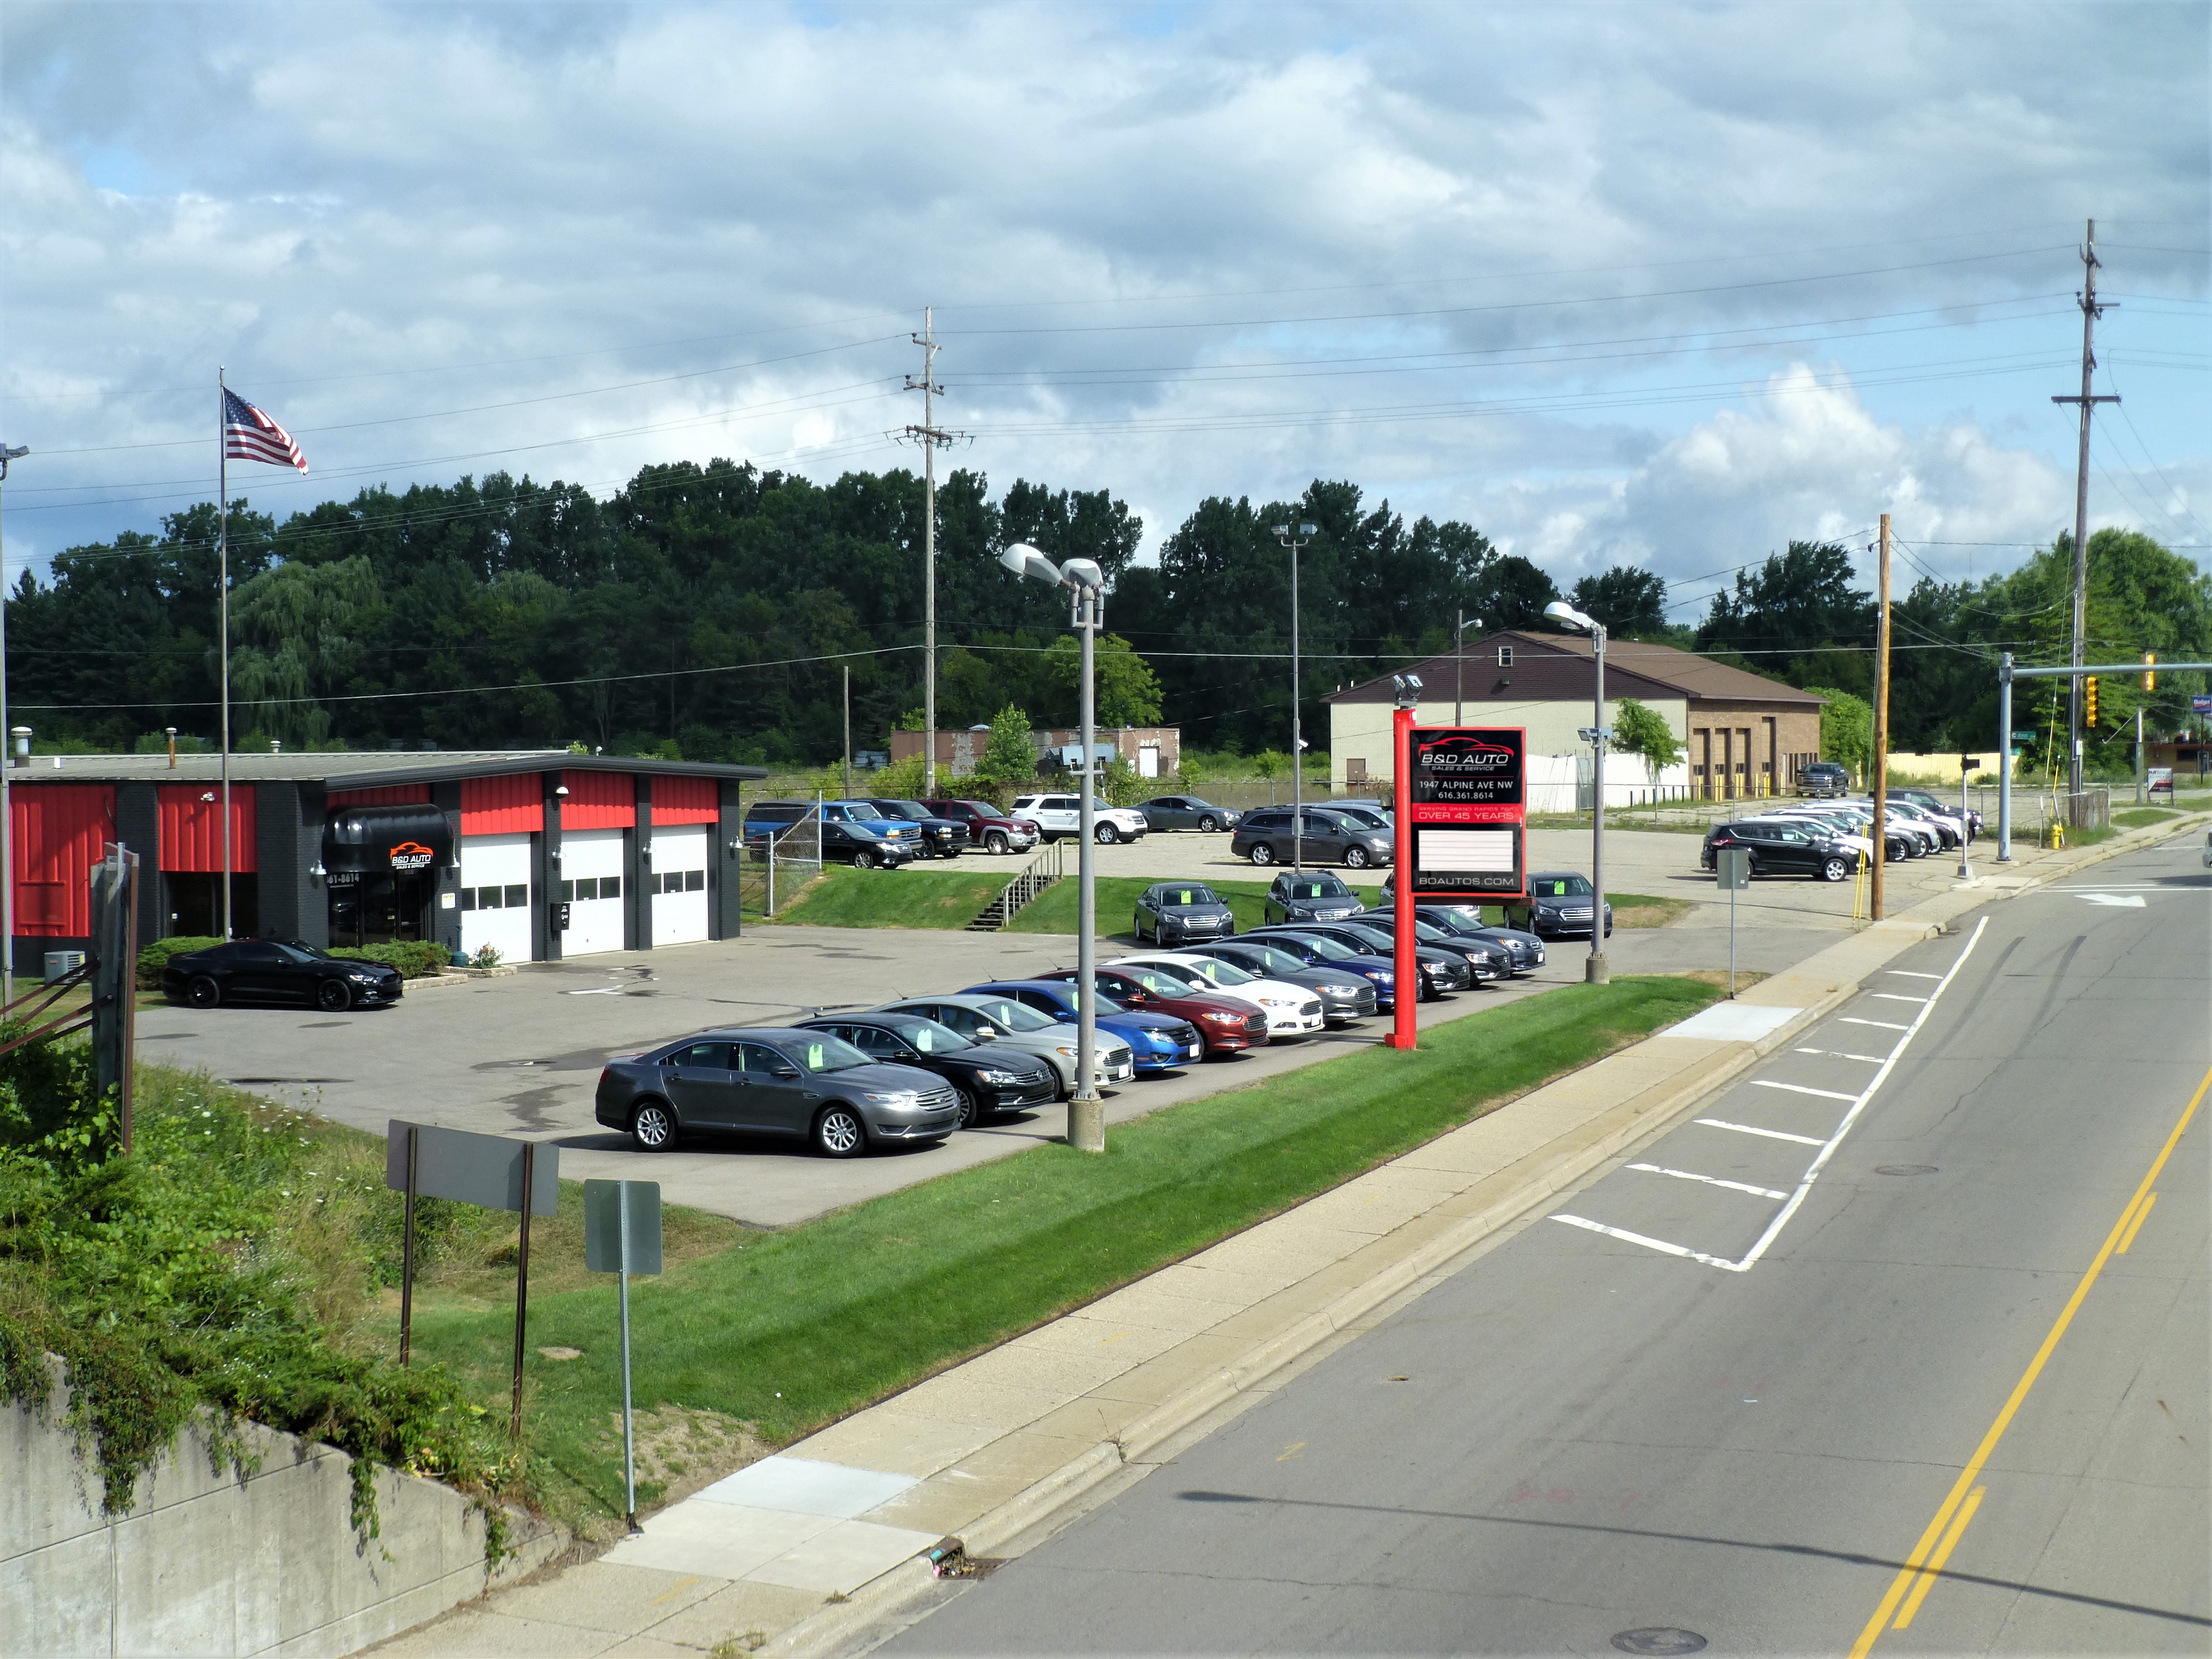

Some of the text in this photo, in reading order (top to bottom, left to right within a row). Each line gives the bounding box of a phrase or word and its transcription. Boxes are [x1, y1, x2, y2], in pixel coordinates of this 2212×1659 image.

[1422, 754, 1508, 764] B&D AUTO
[1442, 781, 1474, 789] ALPINE
[1477, 781, 1494, 789] AVE
[392, 855, 431, 864] B&D AUTO
